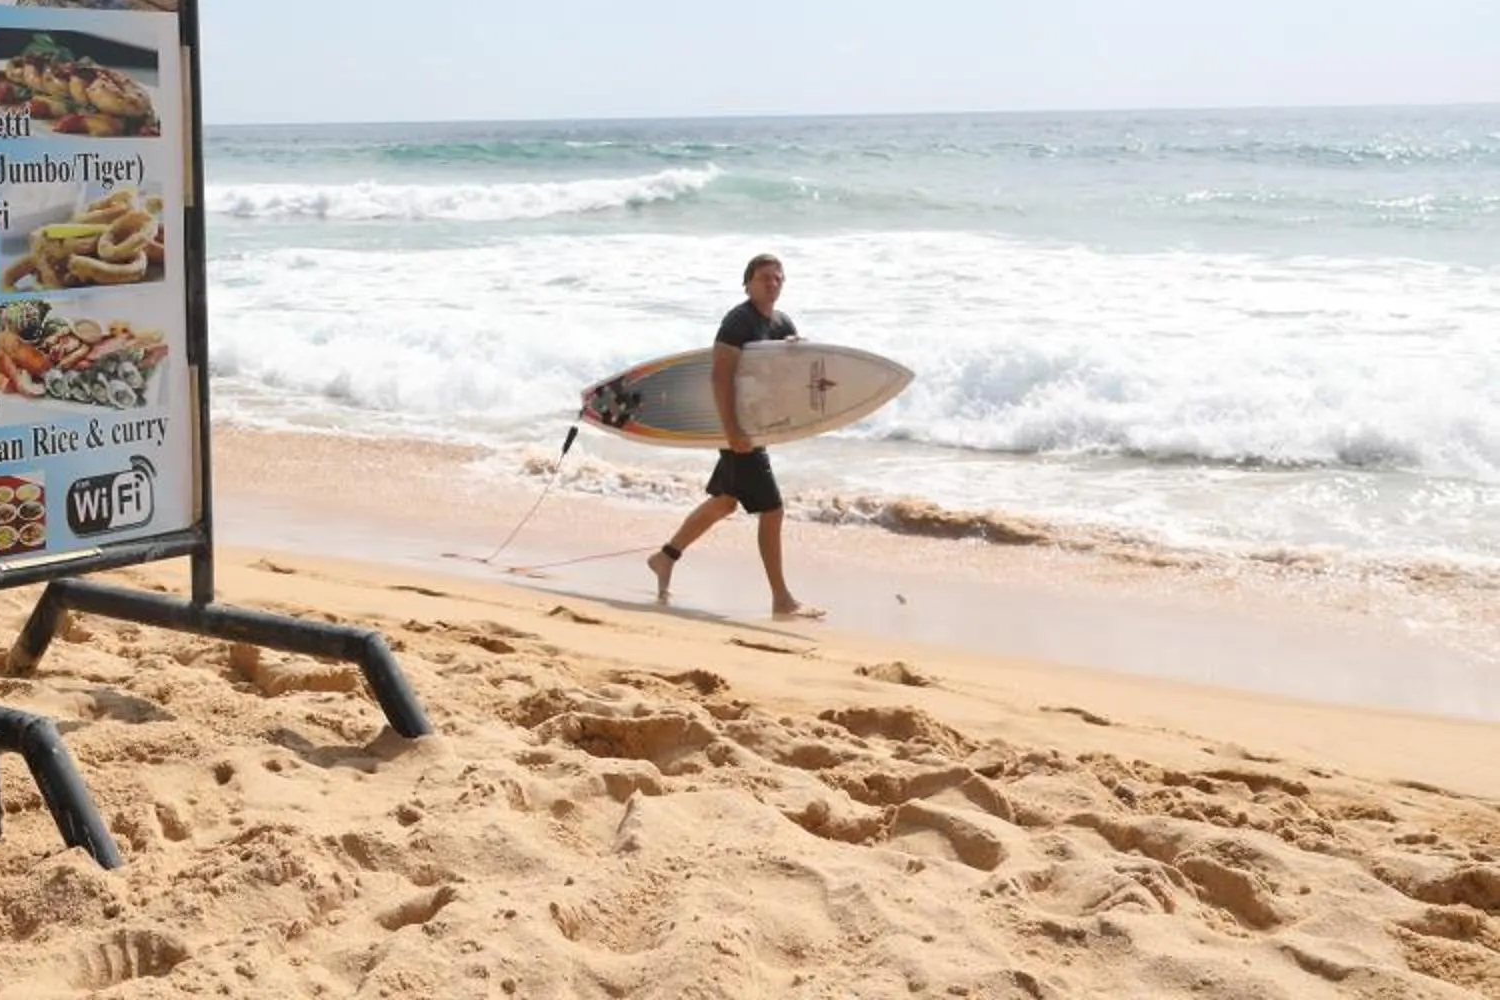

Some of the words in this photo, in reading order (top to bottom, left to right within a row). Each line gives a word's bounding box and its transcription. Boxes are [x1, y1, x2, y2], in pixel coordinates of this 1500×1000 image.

[32, 424, 79, 456] Rice
[86, 419, 104, 448] &
[111, 417, 169, 446] curry
